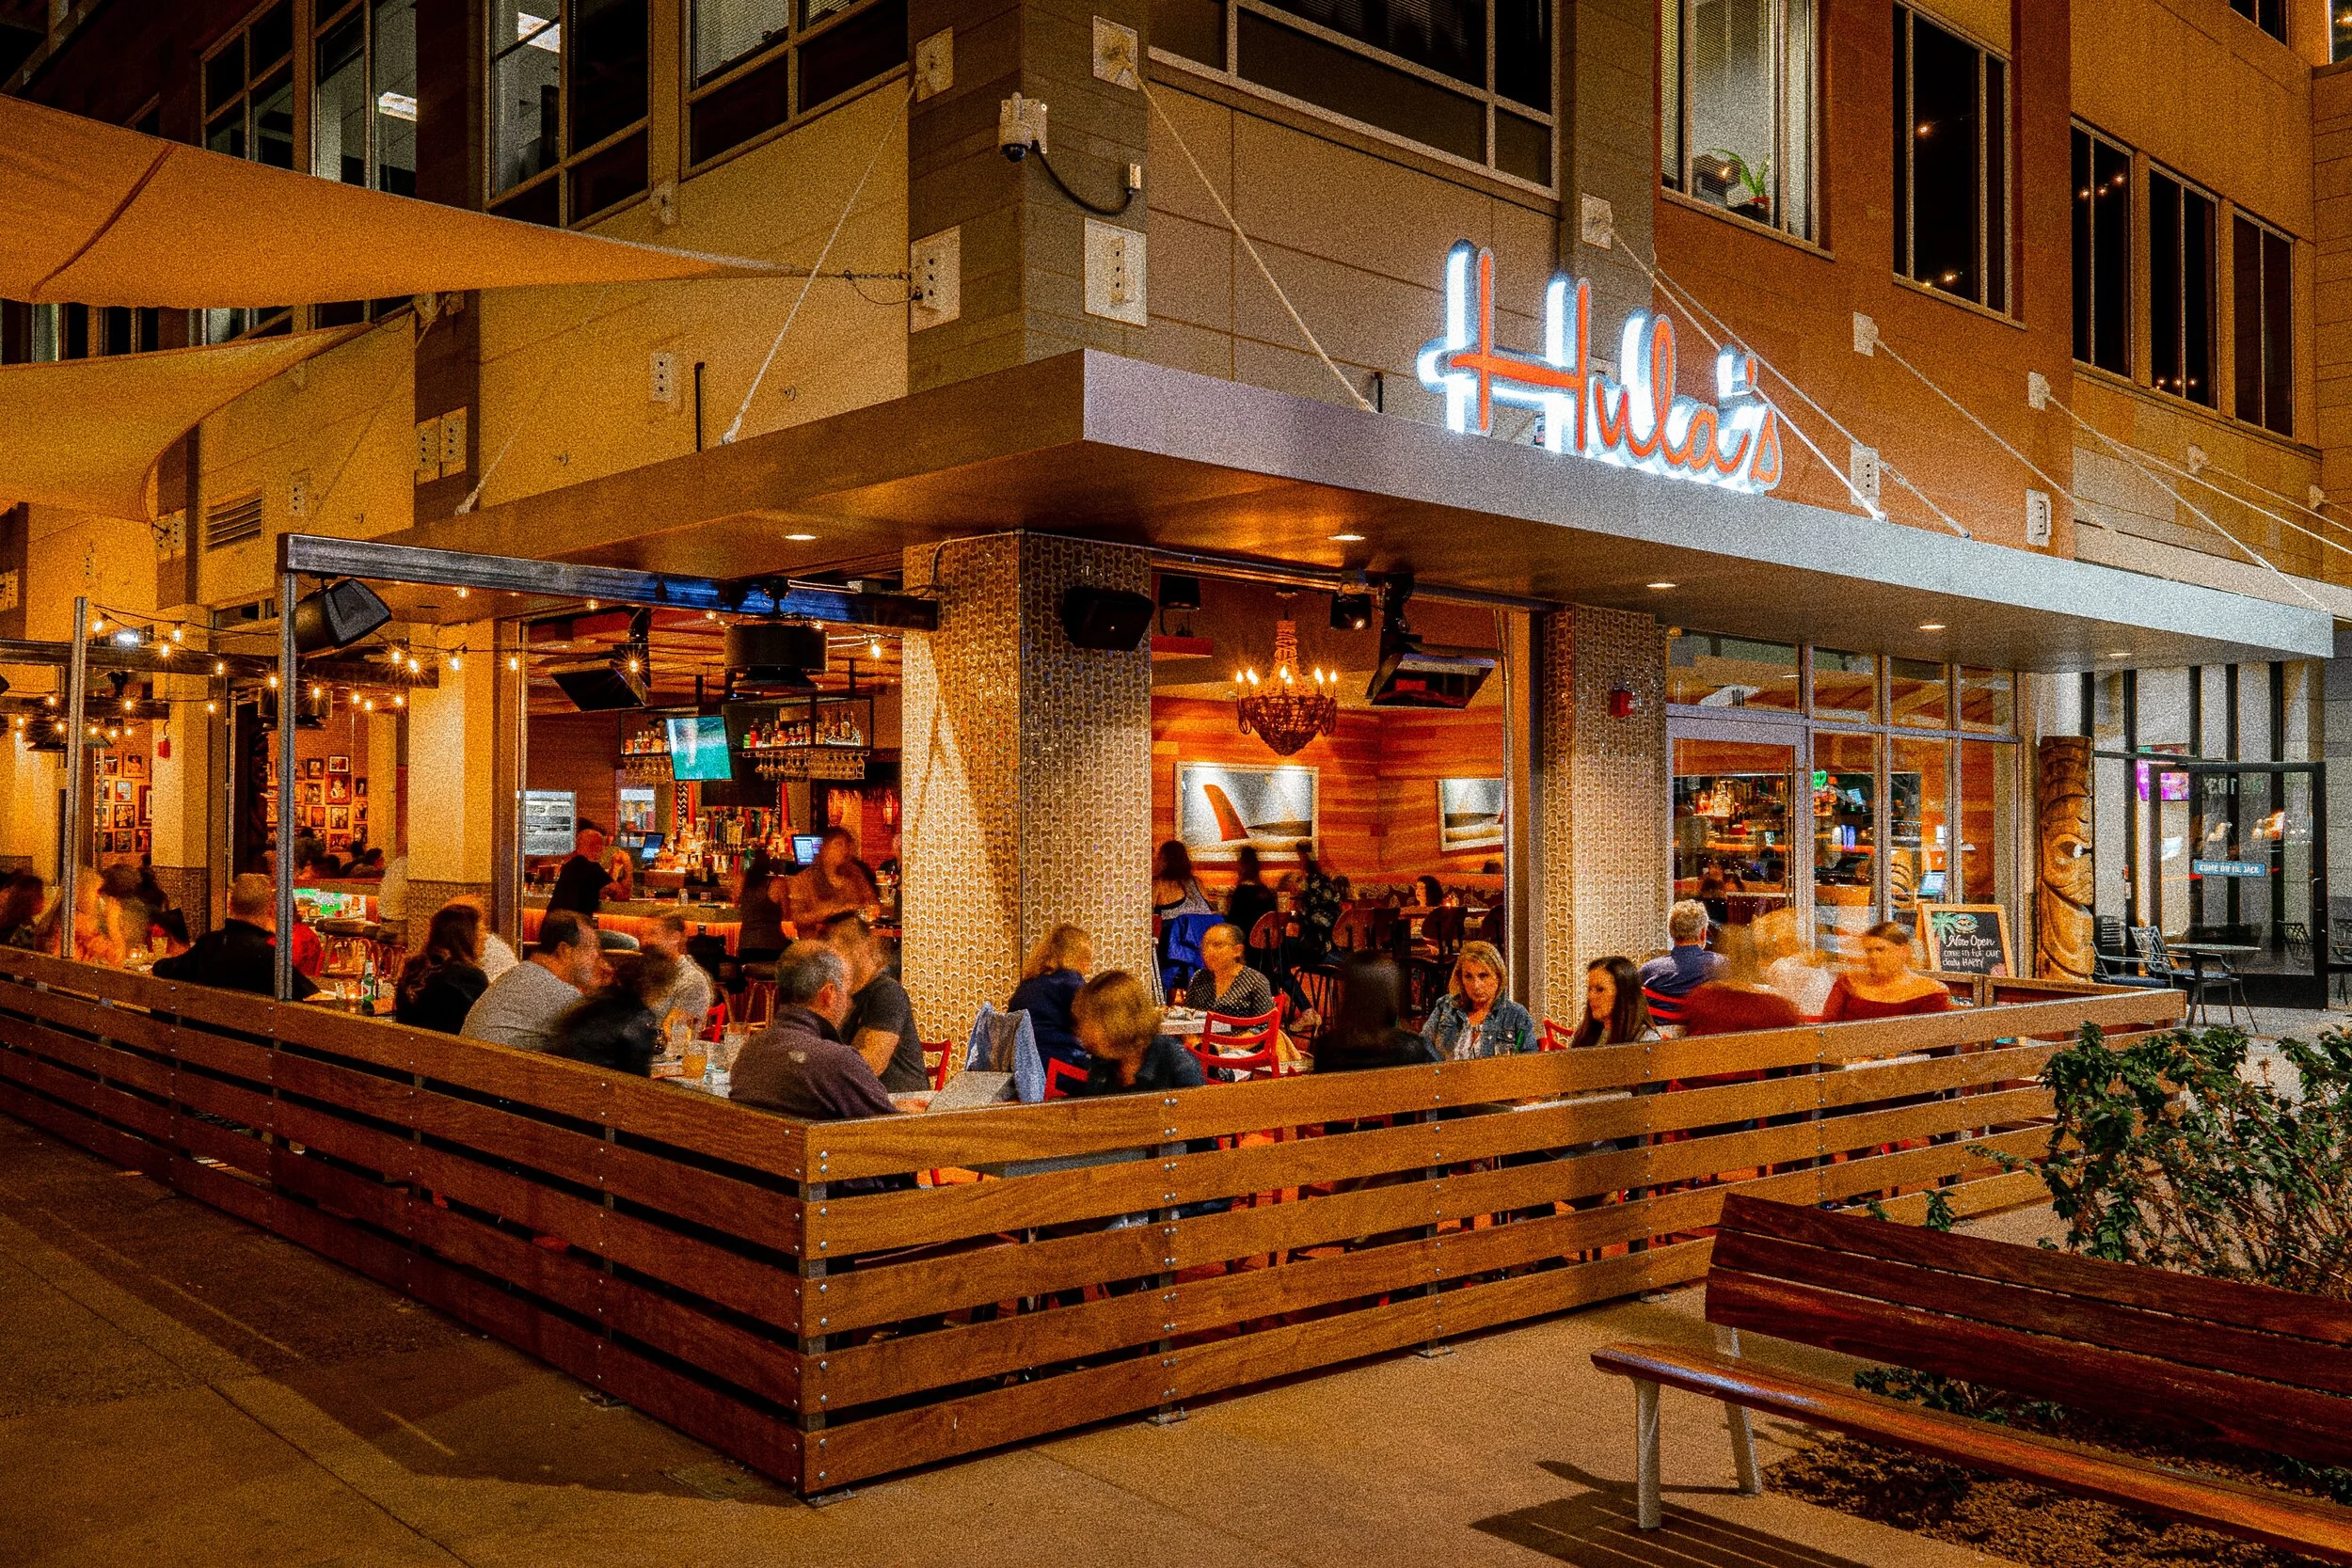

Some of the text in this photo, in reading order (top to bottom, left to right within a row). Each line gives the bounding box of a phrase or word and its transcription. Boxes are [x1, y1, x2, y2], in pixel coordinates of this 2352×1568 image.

[1430, 243, 1783, 492] Hula's
[2199, 863, 2218, 872] COME
[2243, 865, 2260, 874] JACK
[1946, 934, 1995, 950] Now Open
[1962, 958, 1984, 968] HAPPY
